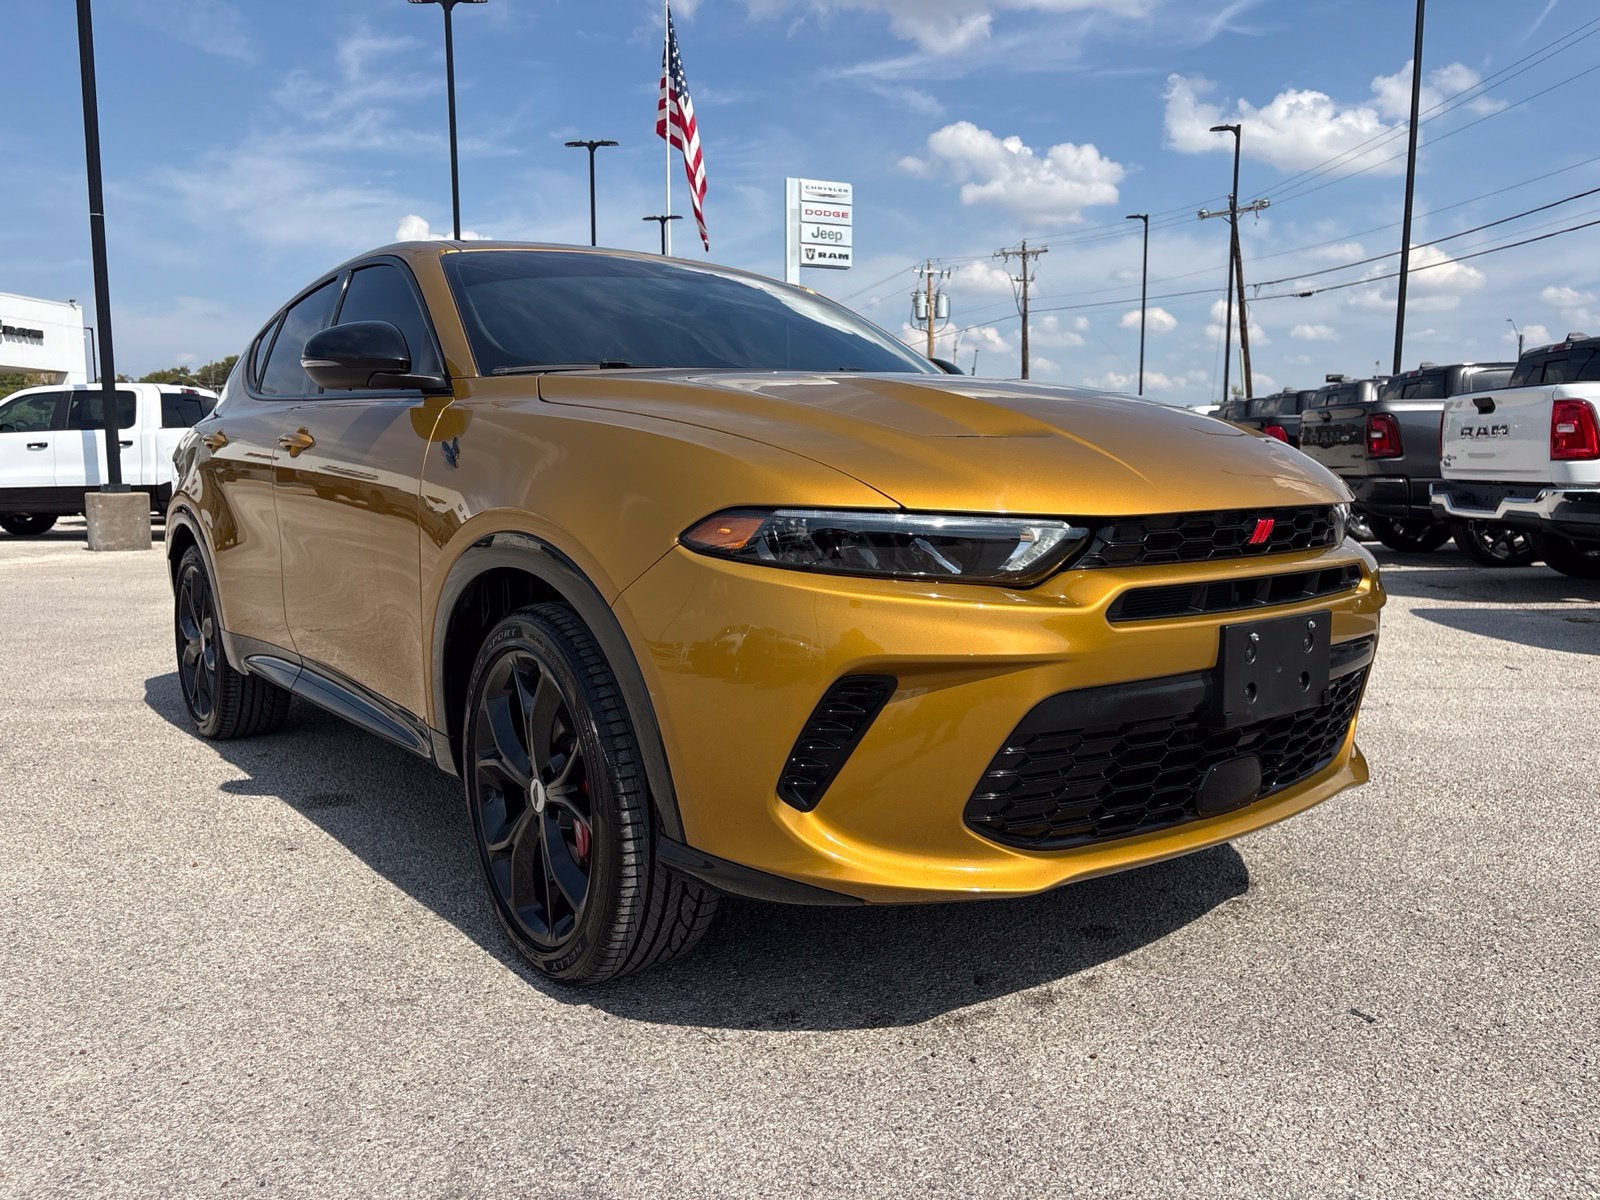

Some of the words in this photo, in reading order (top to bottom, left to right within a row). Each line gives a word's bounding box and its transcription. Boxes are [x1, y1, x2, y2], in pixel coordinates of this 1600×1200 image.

[805, 185, 849, 193] CHRYSLER
[805, 209, 849, 218] DODGE
[811, 226, 843, 243] Jeep
[818, 252, 849, 260] RAM
[1460, 424, 1509, 437] RAM
[486, 628, 517, 651] SPORT
[551, 943, 582, 971] KELLY
